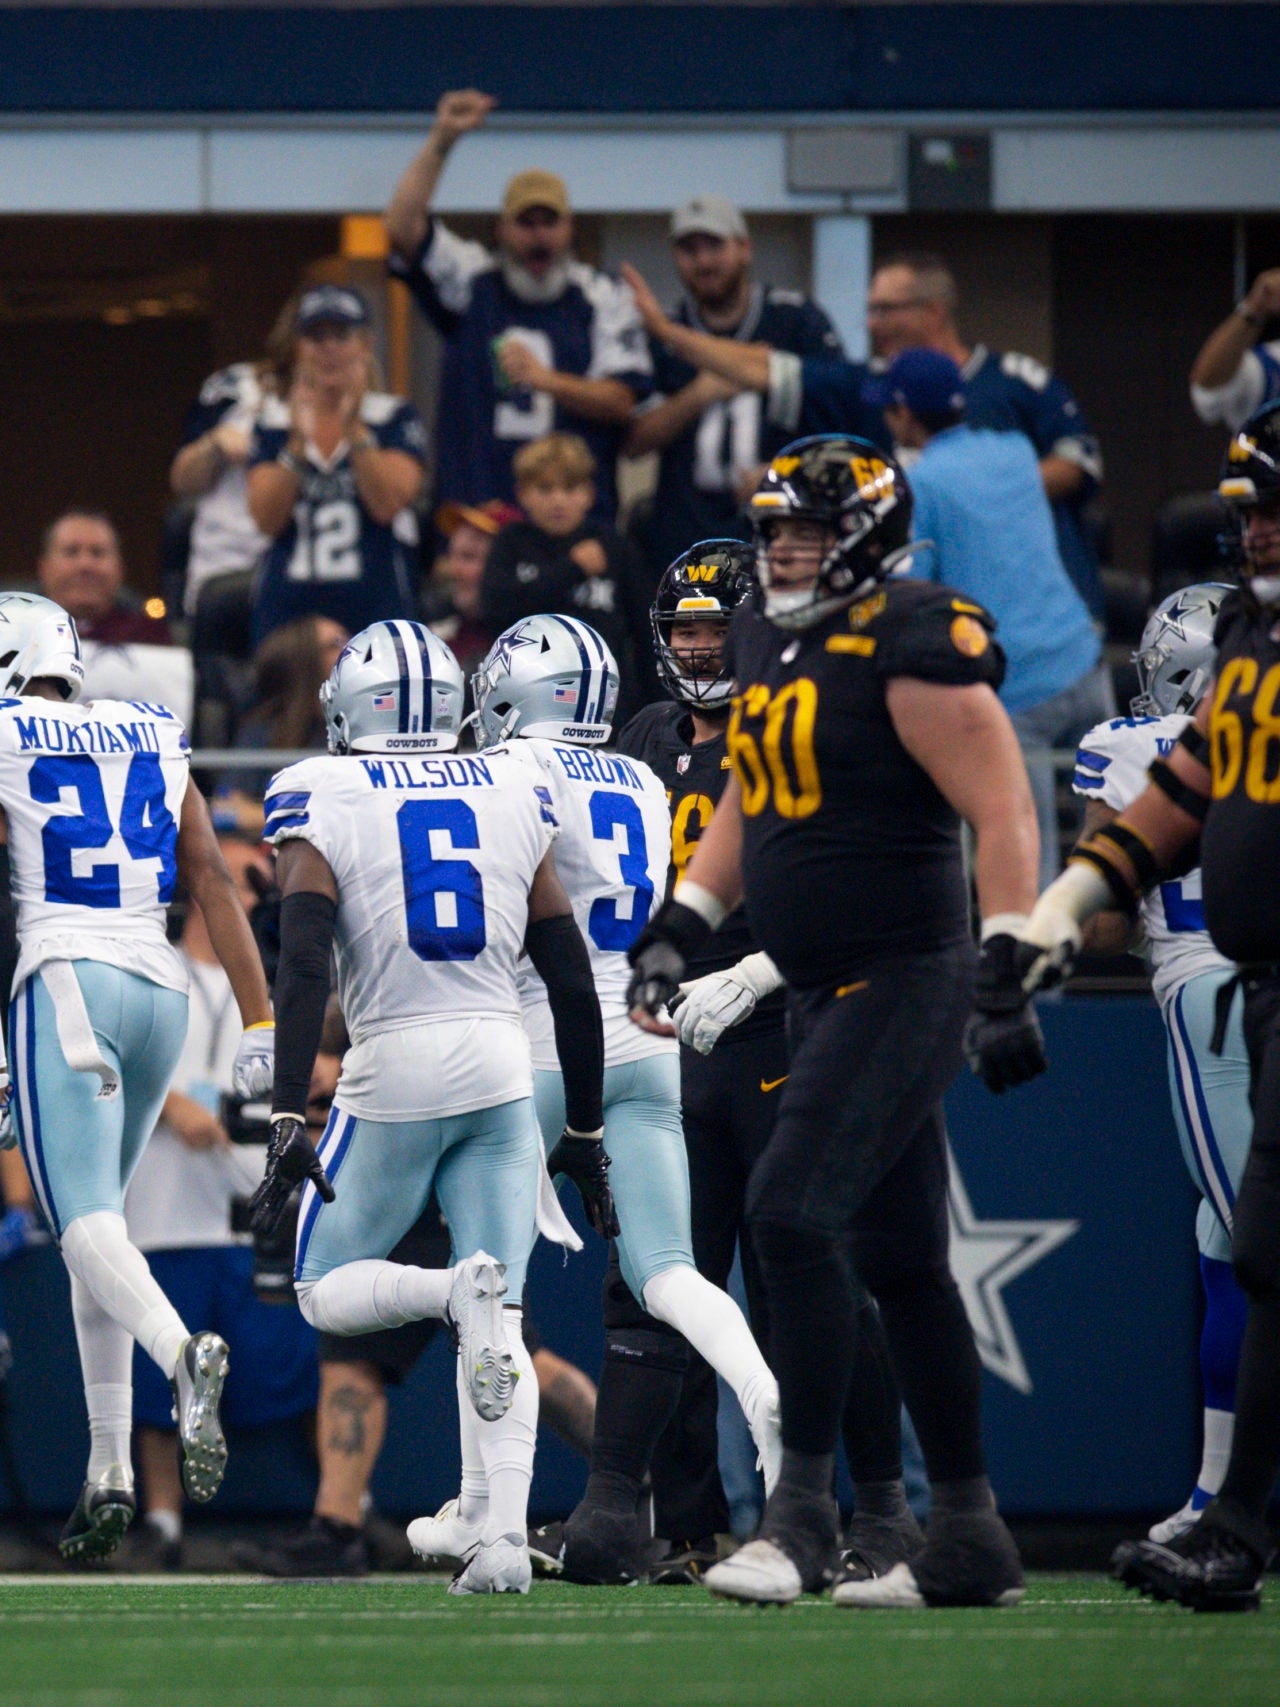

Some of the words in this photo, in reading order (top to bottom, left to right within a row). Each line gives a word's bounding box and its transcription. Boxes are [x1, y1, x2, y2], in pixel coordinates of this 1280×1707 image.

[287, 501, 362, 581] 12
[686, 564, 719, 582] W
[12, 716, 161, 754] MUKUAMU
[386, 738, 438, 749] COWBOYS
[562, 727, 605, 738] COWBOYS
[725, 676, 823, 820] 60
[360, 756, 495, 790] WILSON
[552, 746, 646, 792] BROWN
[27, 752, 179, 909] 24
[666, 792, 716, 898] 6
[396, 798, 487, 962] 6
[588, 790, 655, 952] 3
